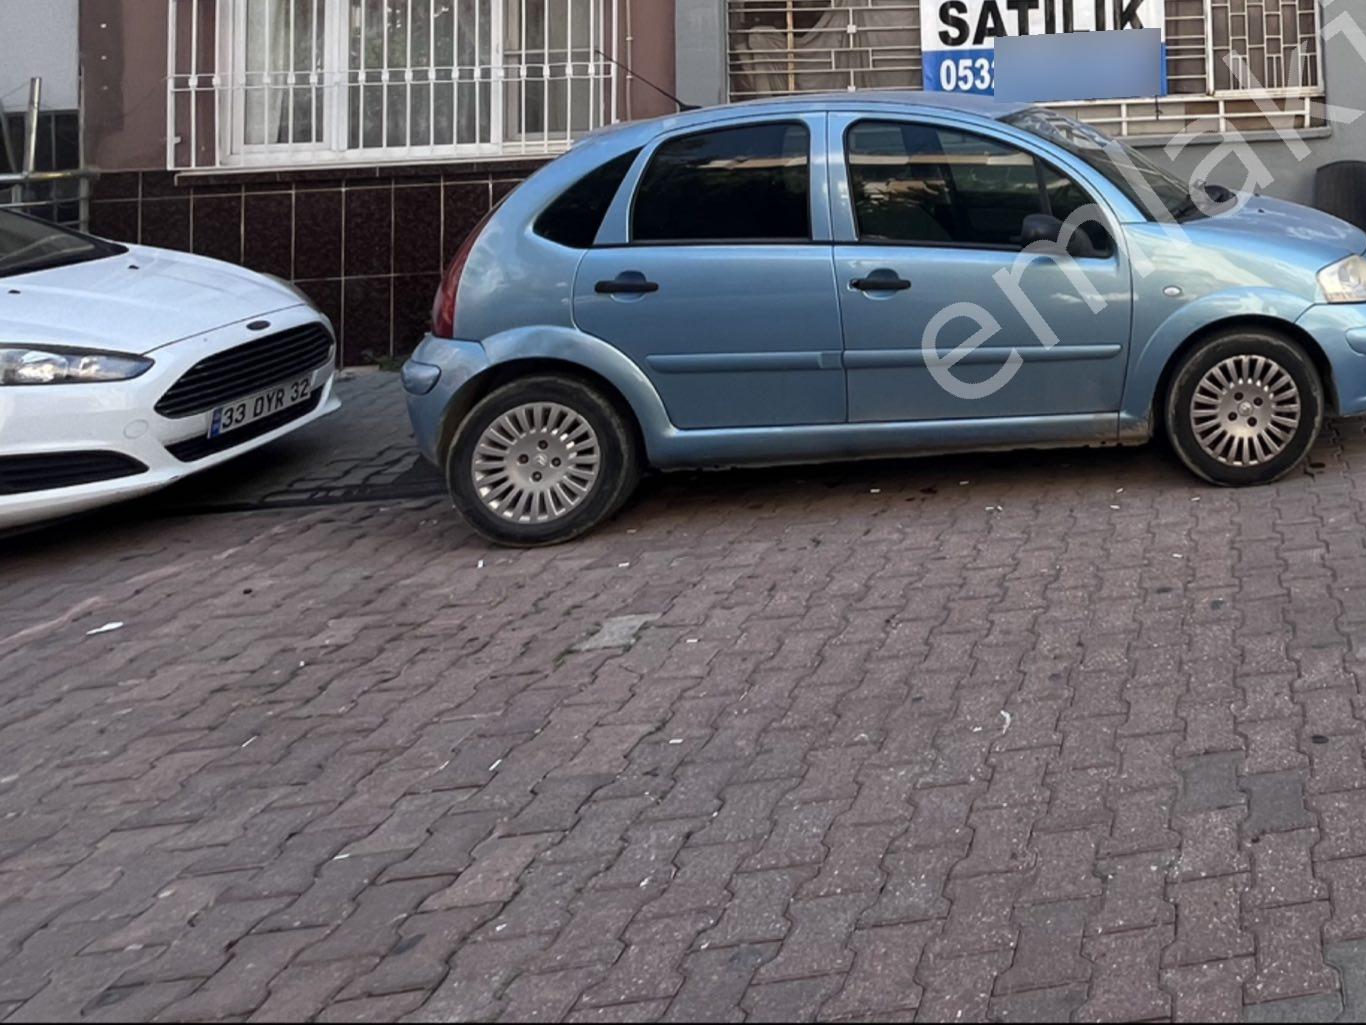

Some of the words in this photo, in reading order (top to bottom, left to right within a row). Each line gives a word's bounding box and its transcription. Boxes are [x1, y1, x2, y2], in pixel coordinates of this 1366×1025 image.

[939, 57, 995, 92] 053
[222, 403, 247, 429] 33
[252, 388, 286, 418] DYR
[290, 378, 310, 402] 32
